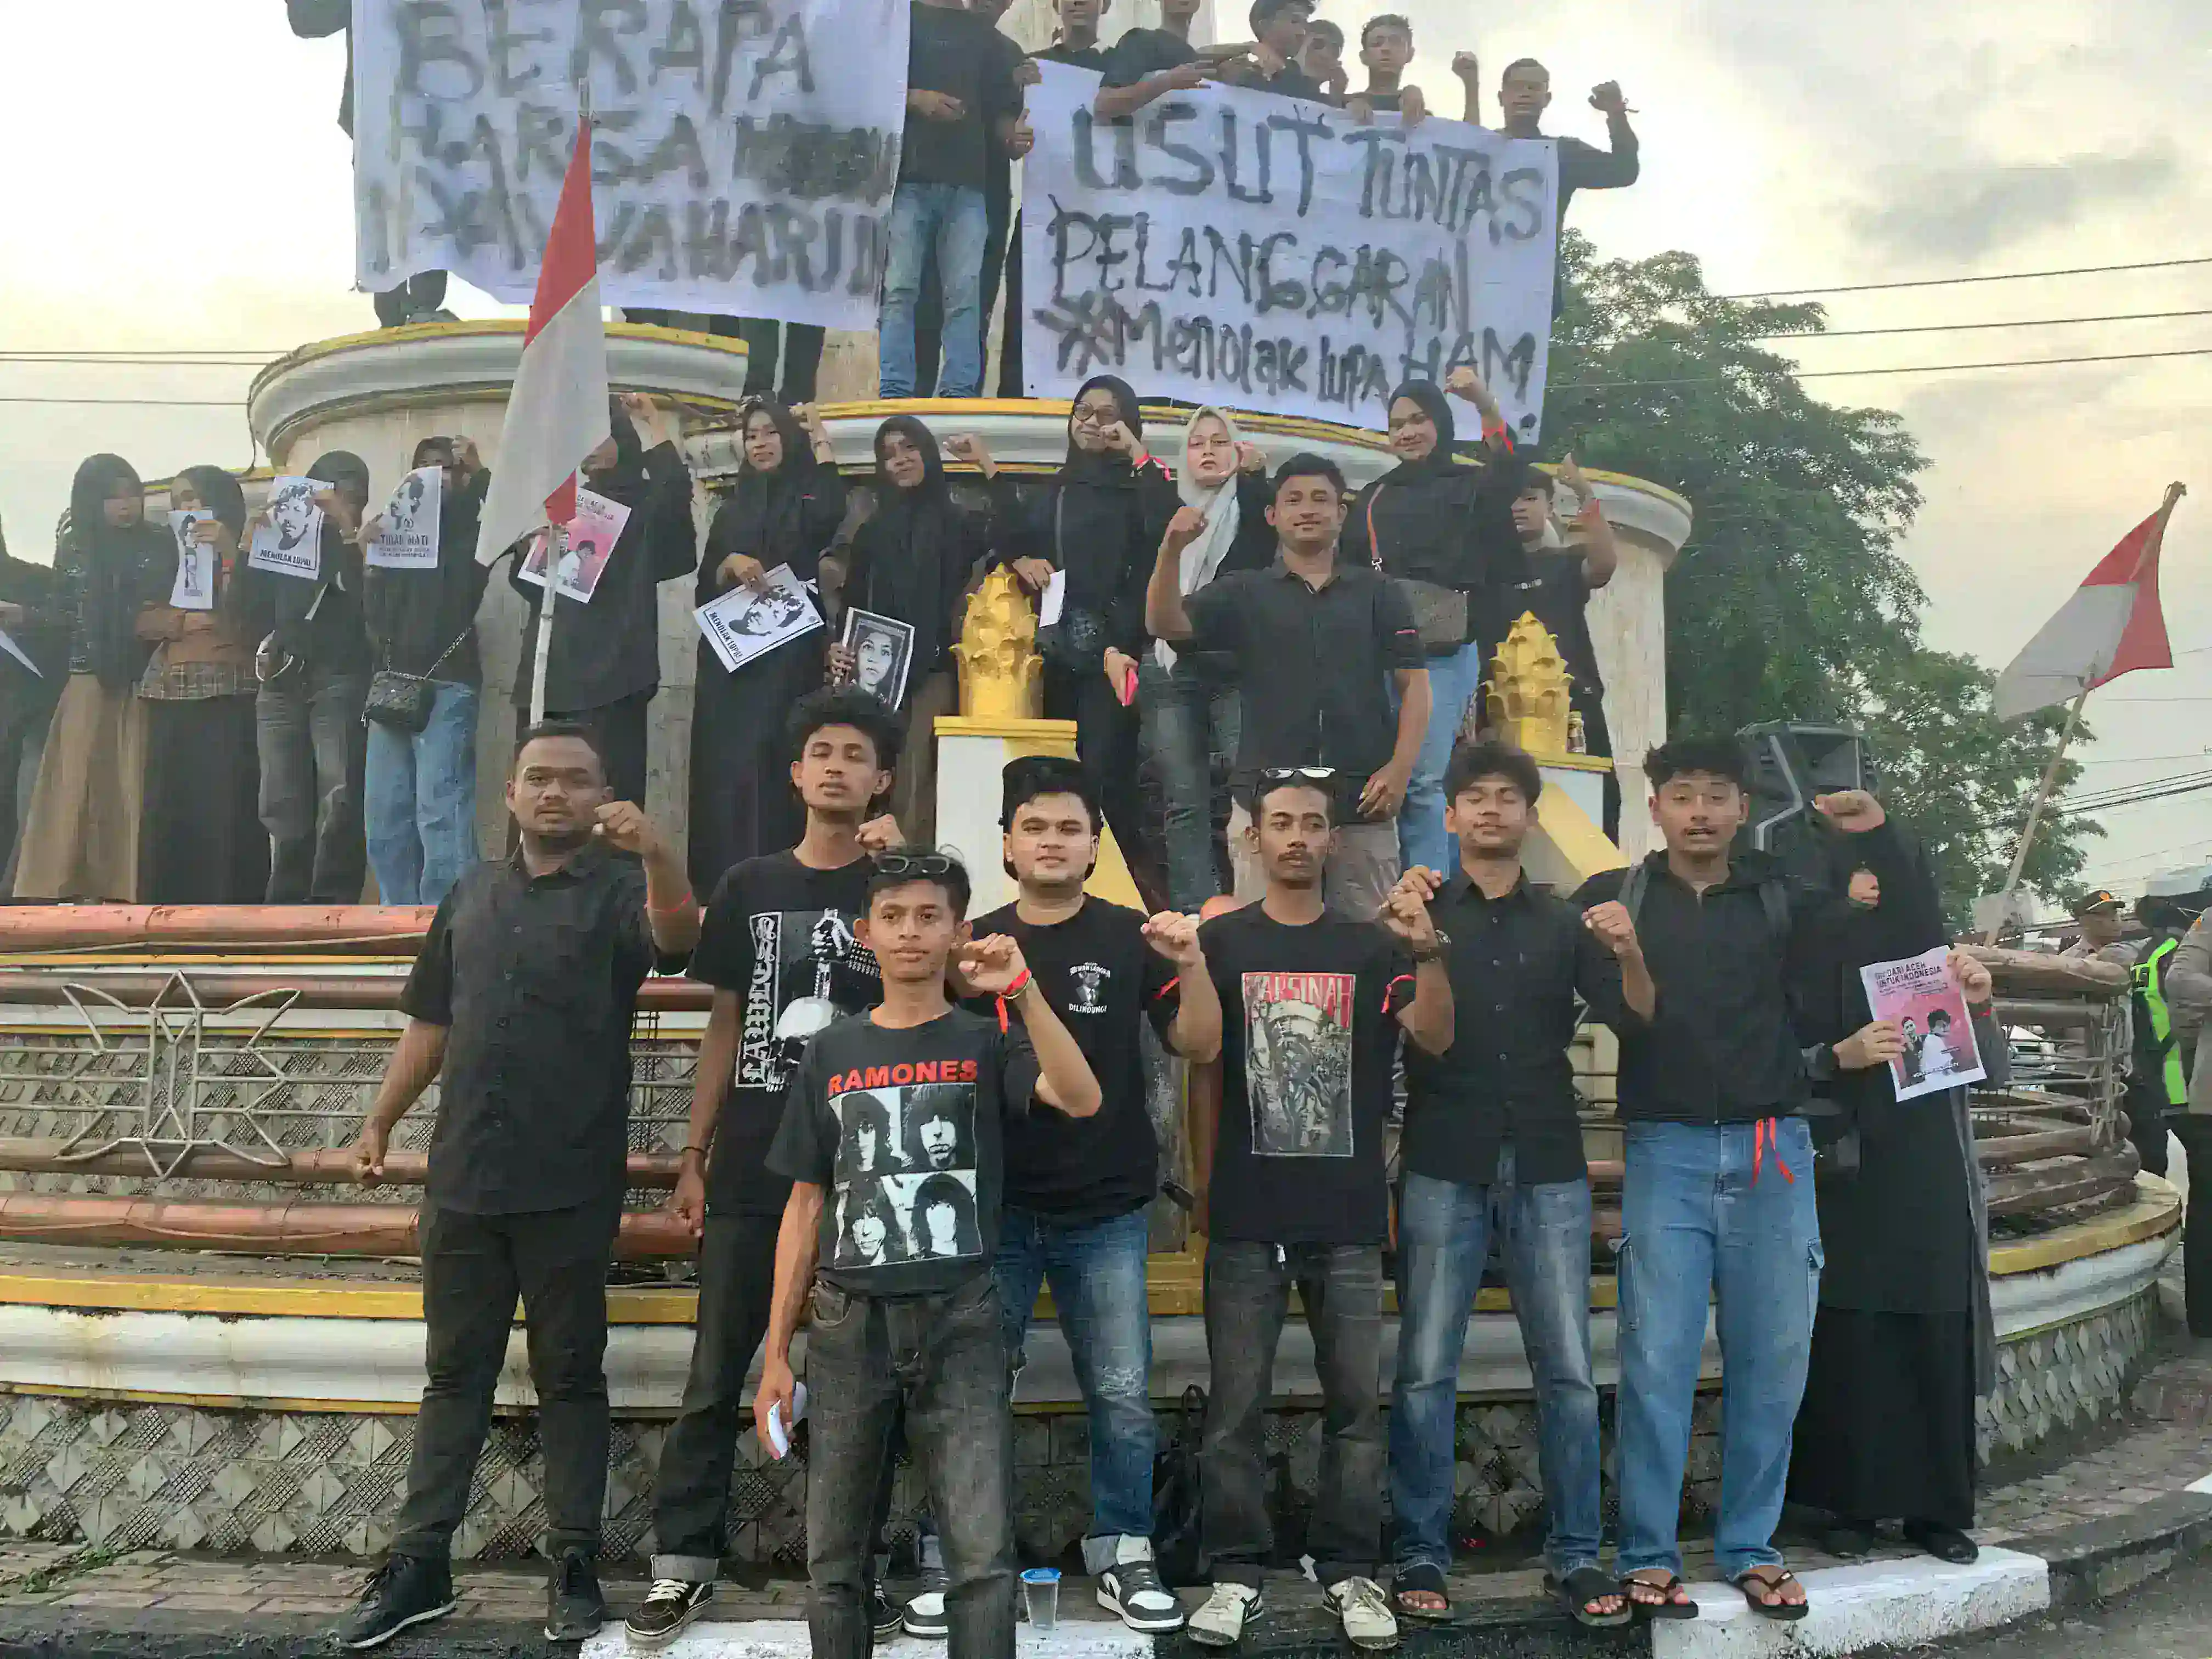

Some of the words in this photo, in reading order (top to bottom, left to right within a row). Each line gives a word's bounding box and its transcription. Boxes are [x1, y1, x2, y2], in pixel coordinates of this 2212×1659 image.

[393, 0, 815, 116] BERAPA
[1073, 101, 1335, 218] USUT
[1342, 128, 1543, 246] TUNTAS
[1046, 195, 1469, 332] PELANGGARAN
[1906, 961, 1926, 972] ACEH
[827, 1059, 977, 1098] RAMONES
